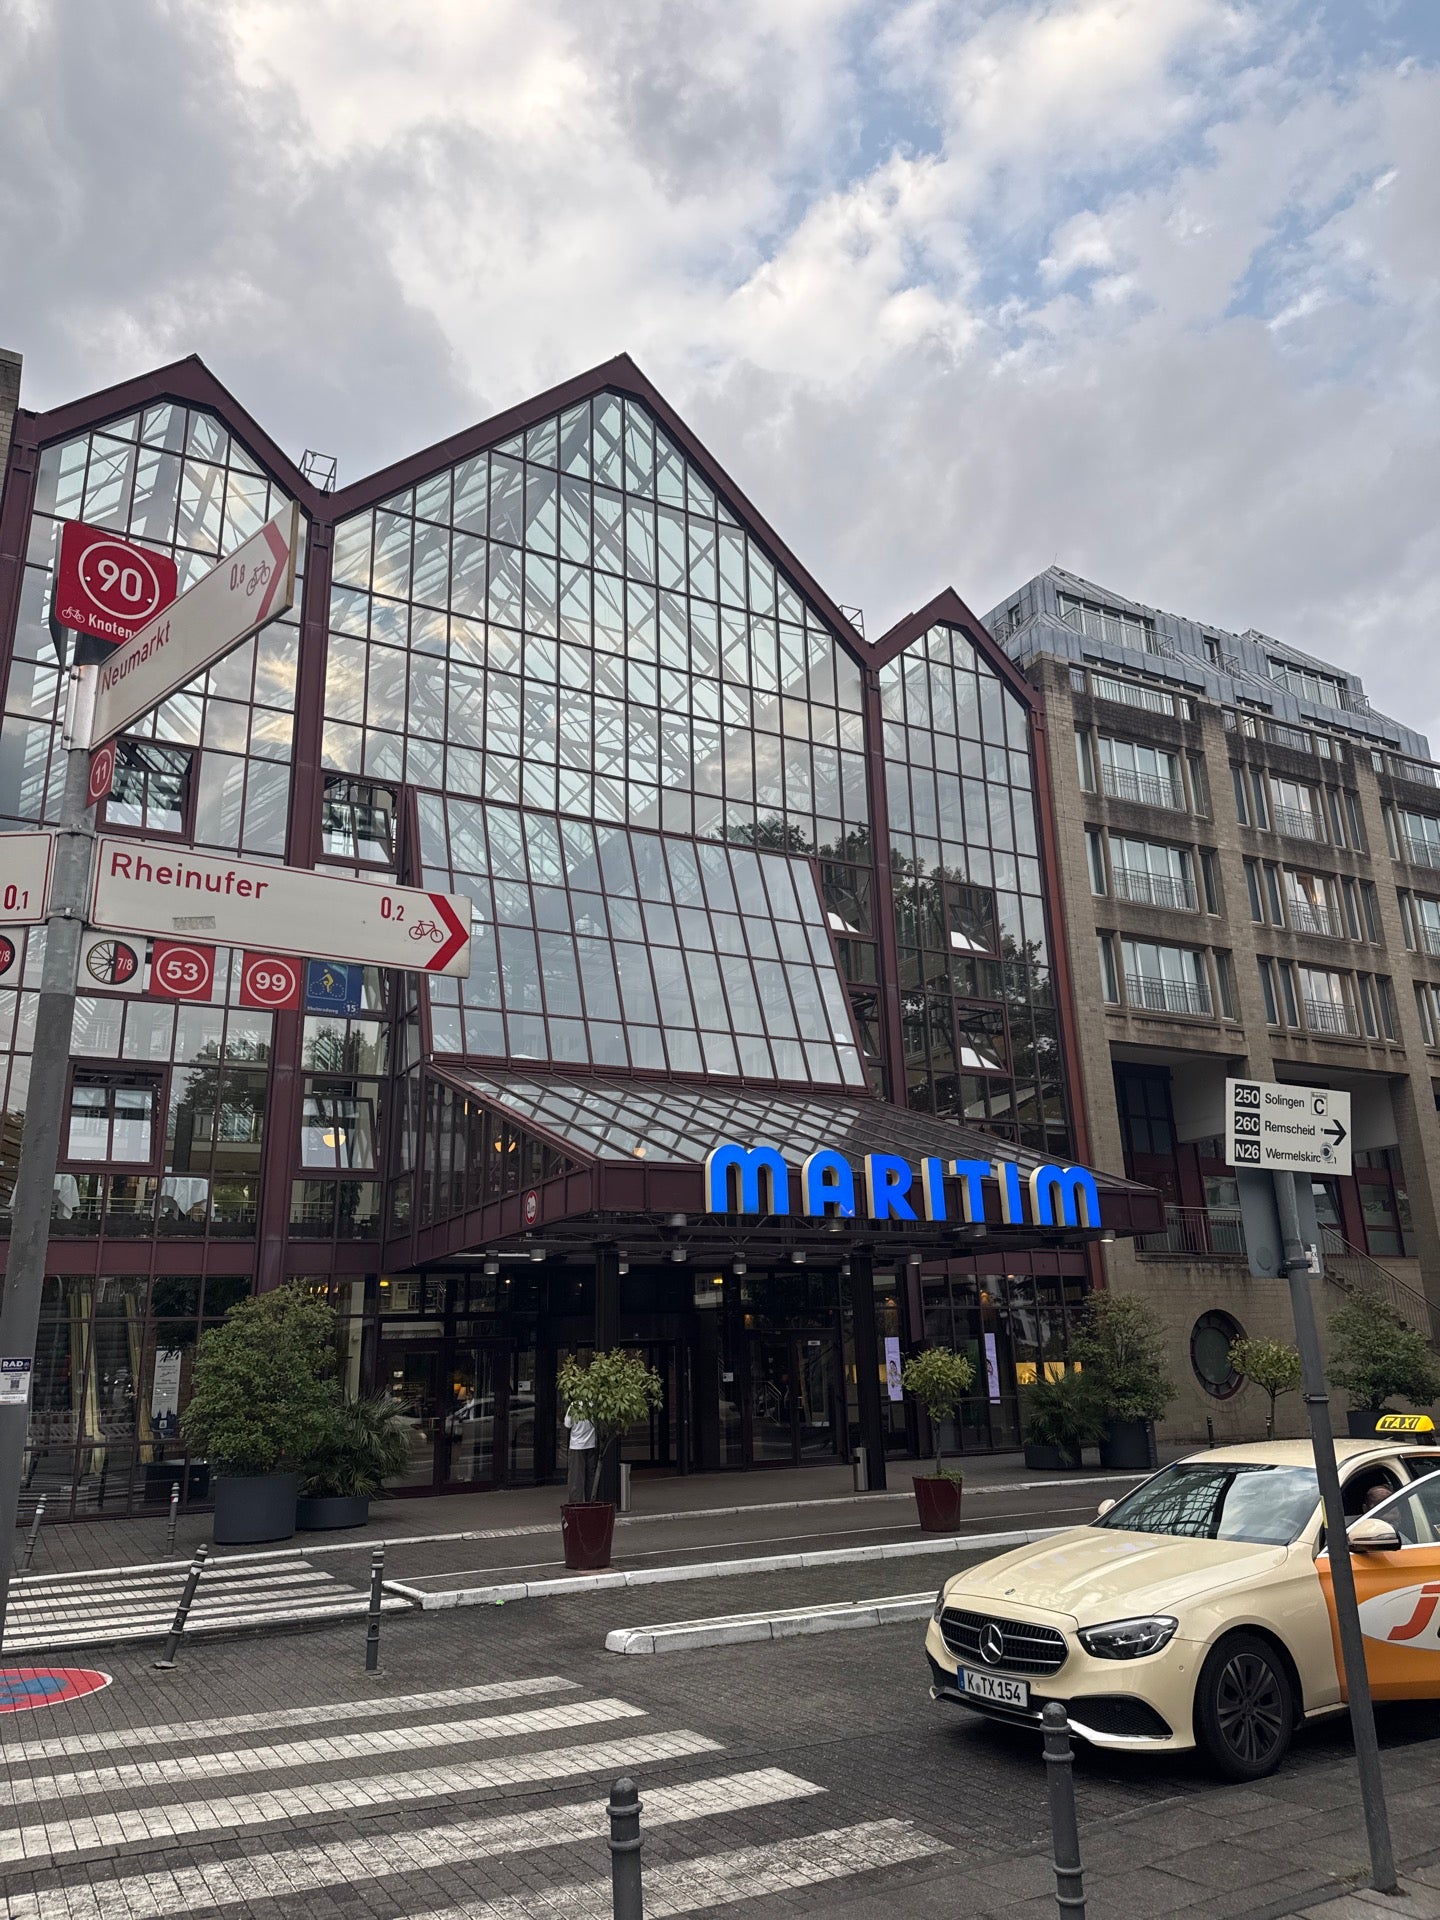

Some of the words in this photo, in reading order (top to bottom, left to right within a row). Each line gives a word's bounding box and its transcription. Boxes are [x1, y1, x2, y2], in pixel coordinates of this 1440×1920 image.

[97, 559, 143, 602] 90
[88, 613, 136, 640] Knoten
[101, 620, 172, 695] Neumarkt
[95, 761, 107, 784] 11
[110, 852, 269, 900] Rheinufer
[380, 896, 405, 922] 0,2
[117, 957, 133, 971] 7/8
[166, 960, 199, 982] 53
[255, 971, 287, 992] 99
[345, 1004, 357, 1013] 15
[1235, 1088, 1260, 1105] 250
[1264, 1092, 1305, 1110] Solingen
[1313, 1098, 1325, 1115] C
[1264, 1120, 1316, 1137] Remscheid
[1235, 1143, 1260, 1160] N26
[705, 1143, 1101, 1229] MARITIM
[2, 1360, 24, 1368] RAD
[1384, 1417, 1419, 1429] TAXI
